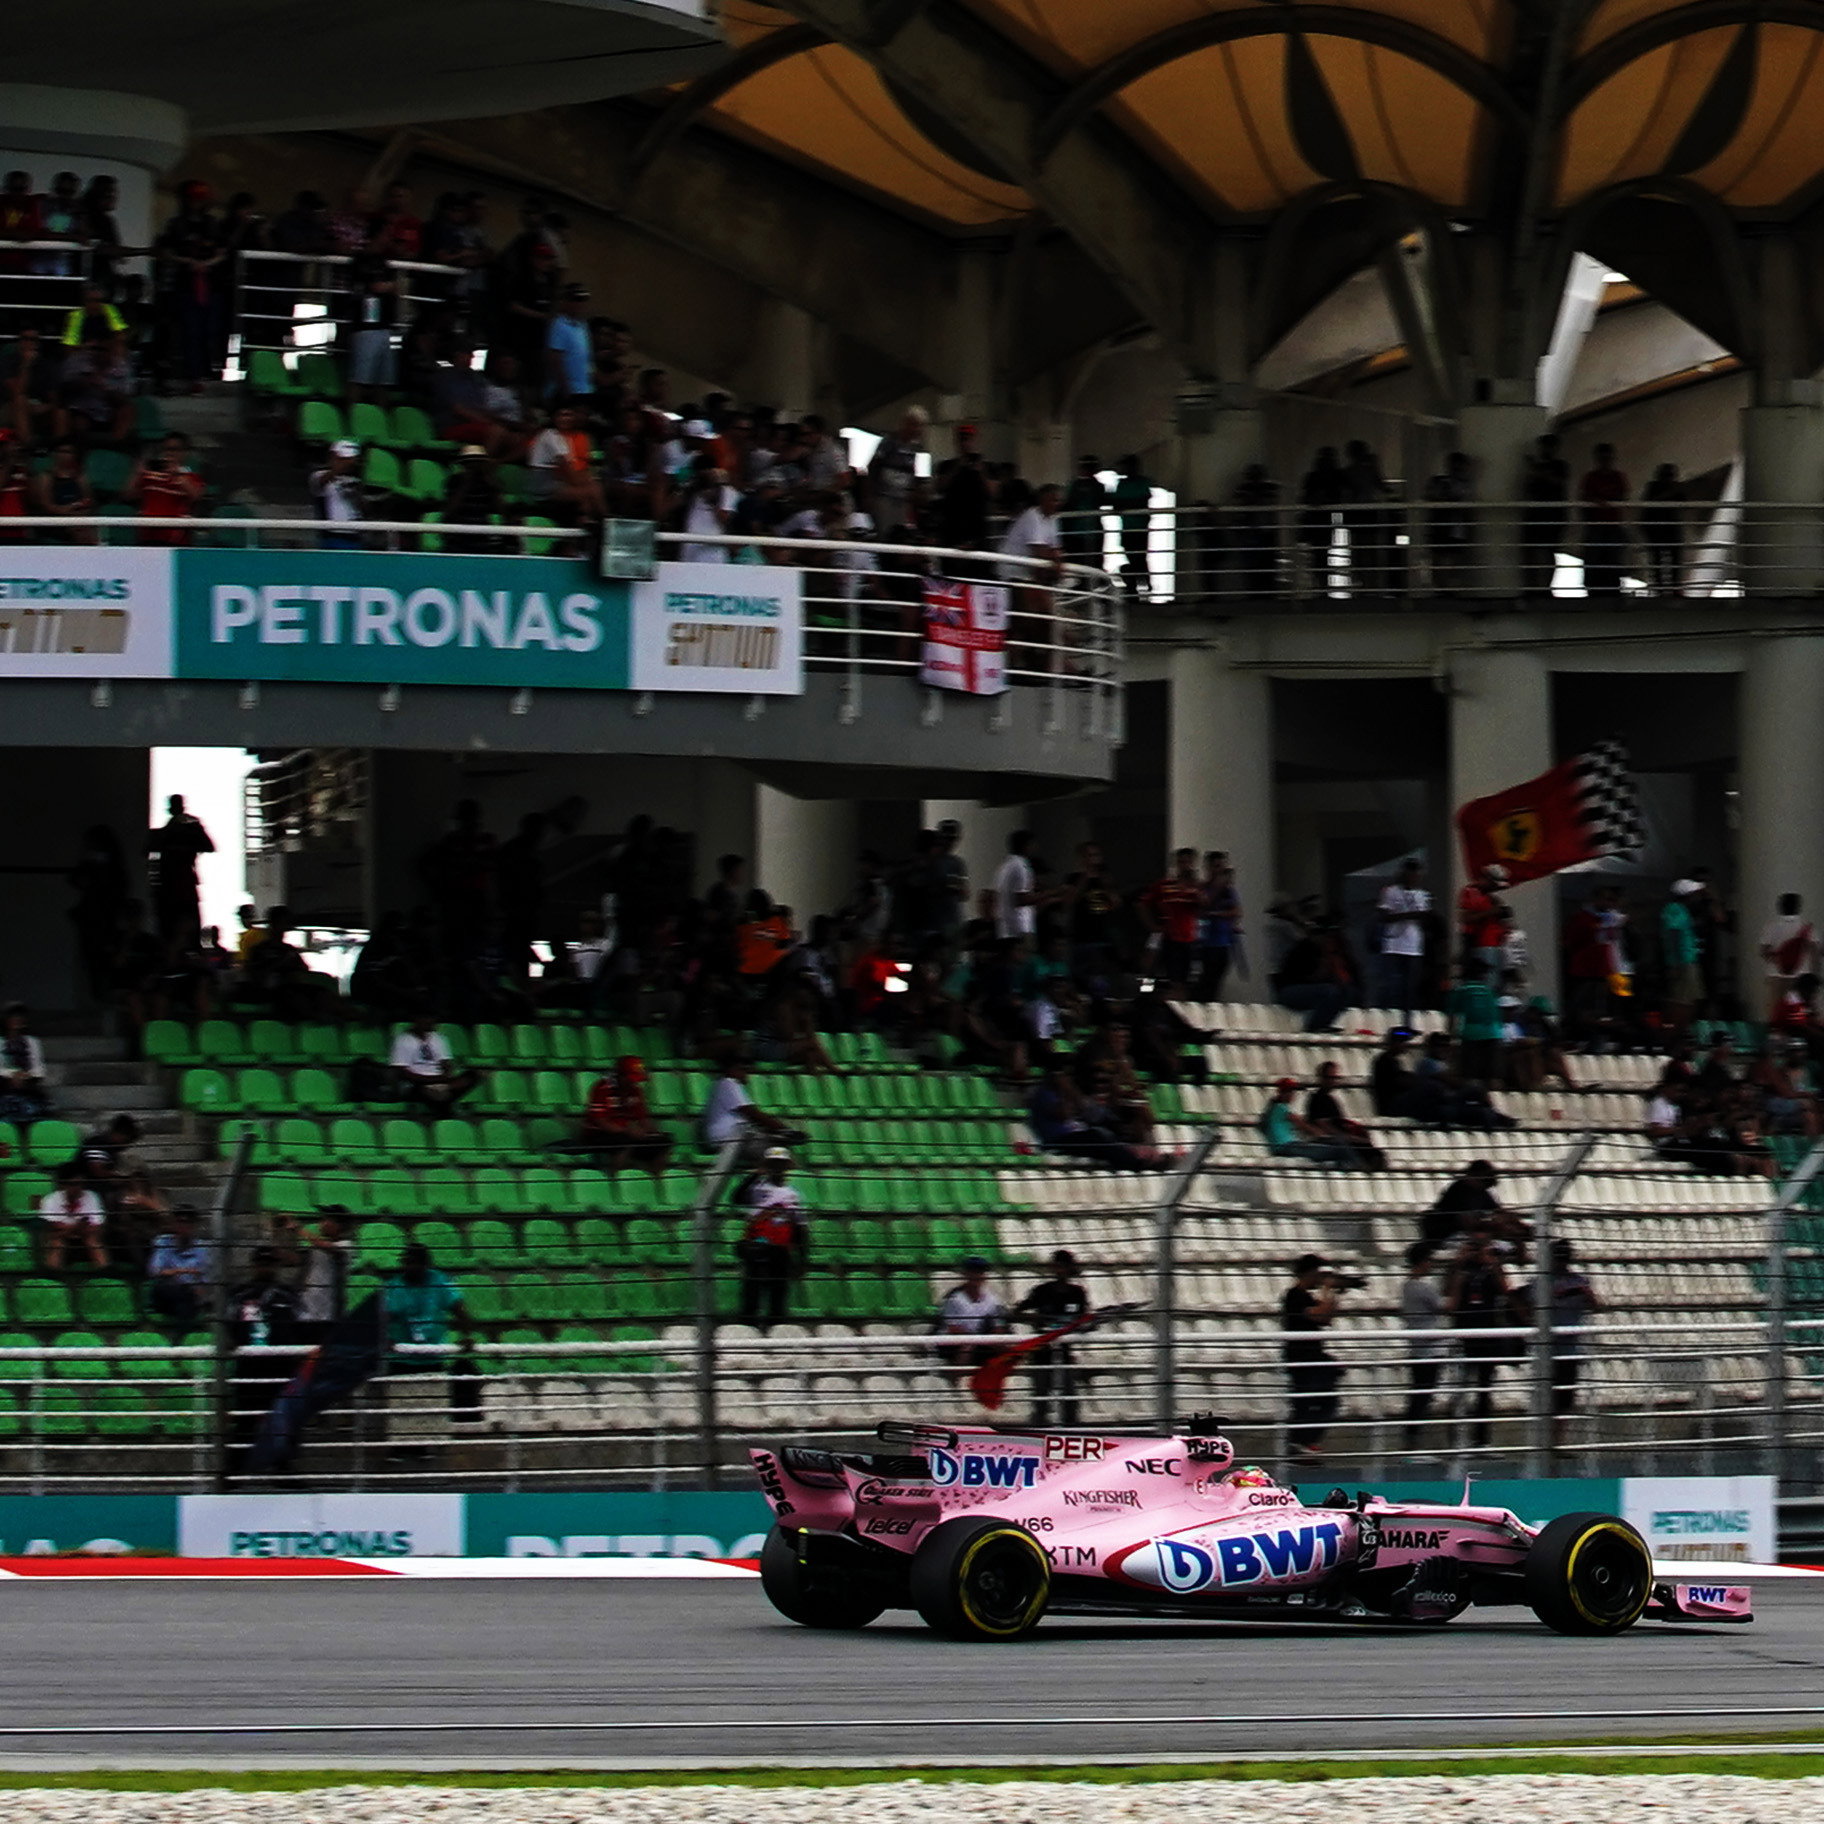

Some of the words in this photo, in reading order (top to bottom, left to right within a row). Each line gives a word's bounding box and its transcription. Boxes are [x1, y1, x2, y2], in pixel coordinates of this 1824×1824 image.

[664, 592, 782, 617] PETRONAS
[211, 584, 602, 653] PETRONAS
[1045, 1437, 1103, 1460] PER
[1187, 1439, 1230, 1454] HYPE
[962, 1455, 1041, 1488] BWT
[1125, 1458, 1182, 1477] NEC
[753, 1453, 796, 1517] HYPE
[1062, 1490, 1144, 1510] KINGFISHER
[1248, 1492, 1289, 1506] Claro
[863, 1517, 918, 1534] telcel
[229, 1531, 414, 1557] PETRONAS
[1216, 1521, 1343, 1586] BWT
[1688, 1587, 1727, 1603] BWT
